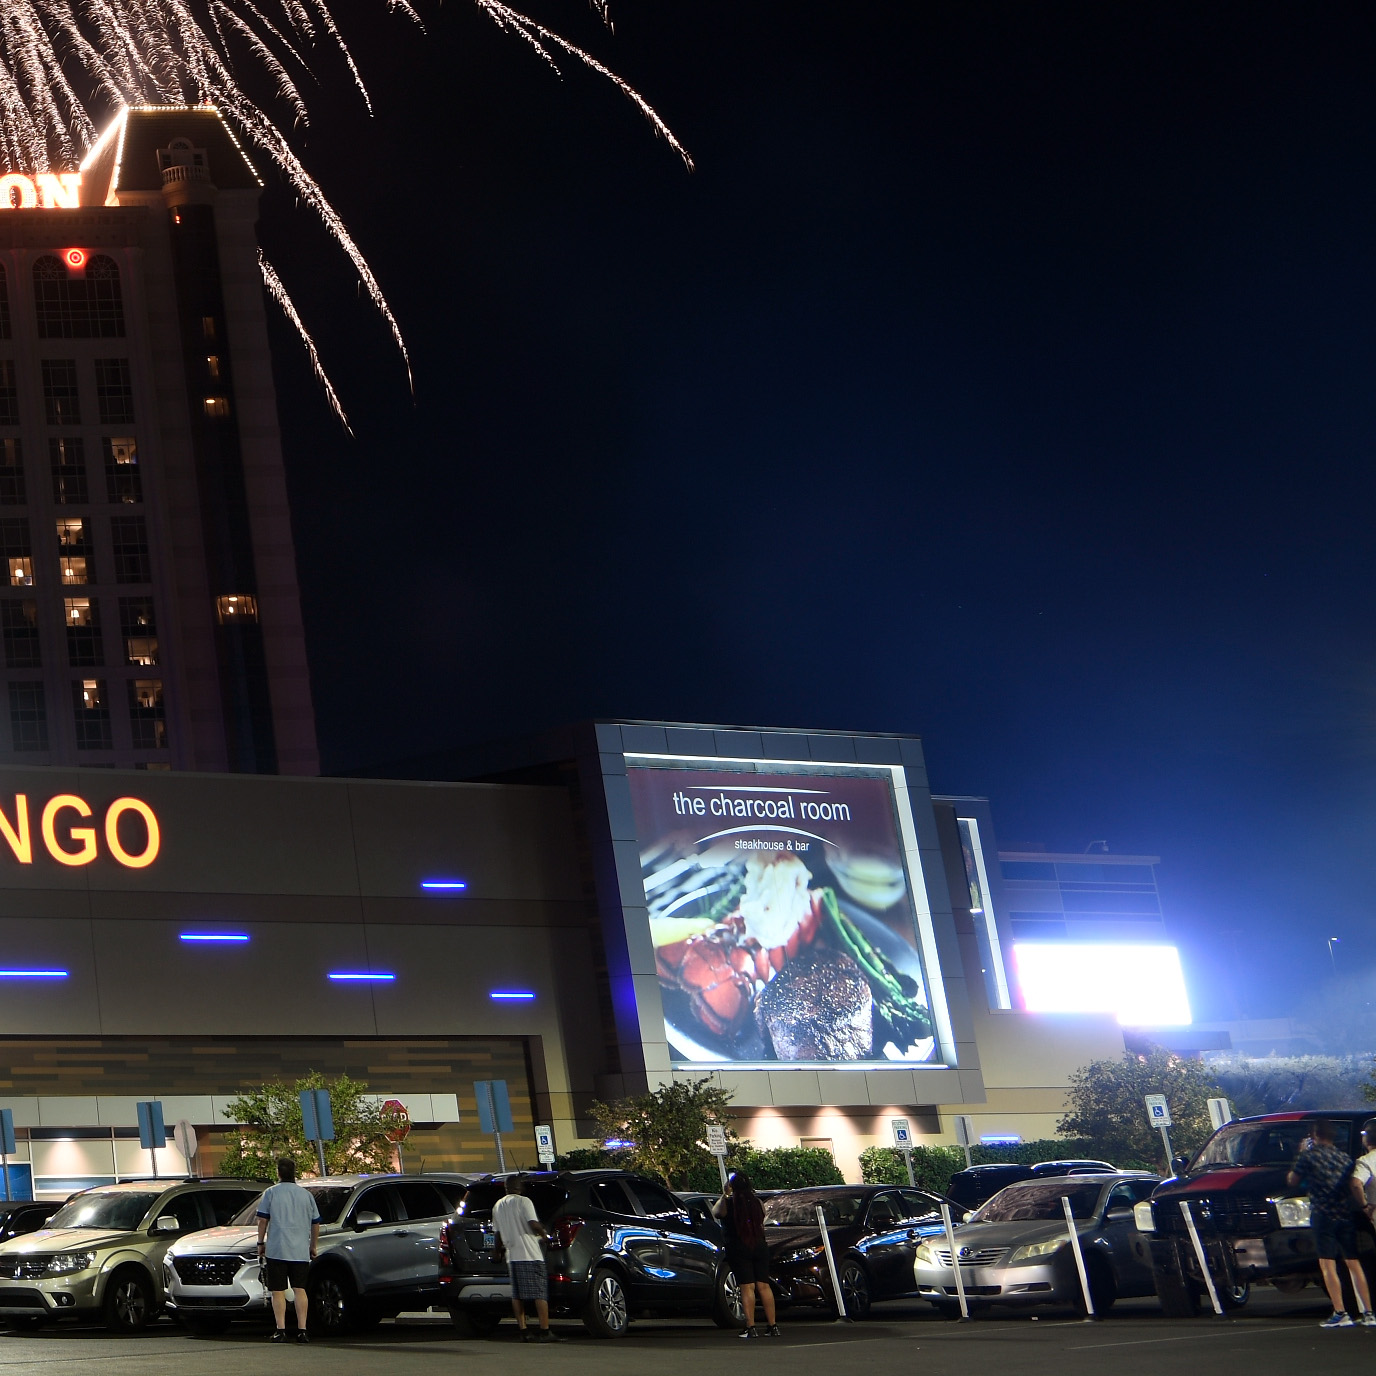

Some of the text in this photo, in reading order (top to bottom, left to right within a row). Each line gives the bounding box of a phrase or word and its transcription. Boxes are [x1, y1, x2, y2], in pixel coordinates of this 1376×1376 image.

[673, 791, 851, 821] the charcoal room
[734, 839, 810, 851] steakhouse & bar
